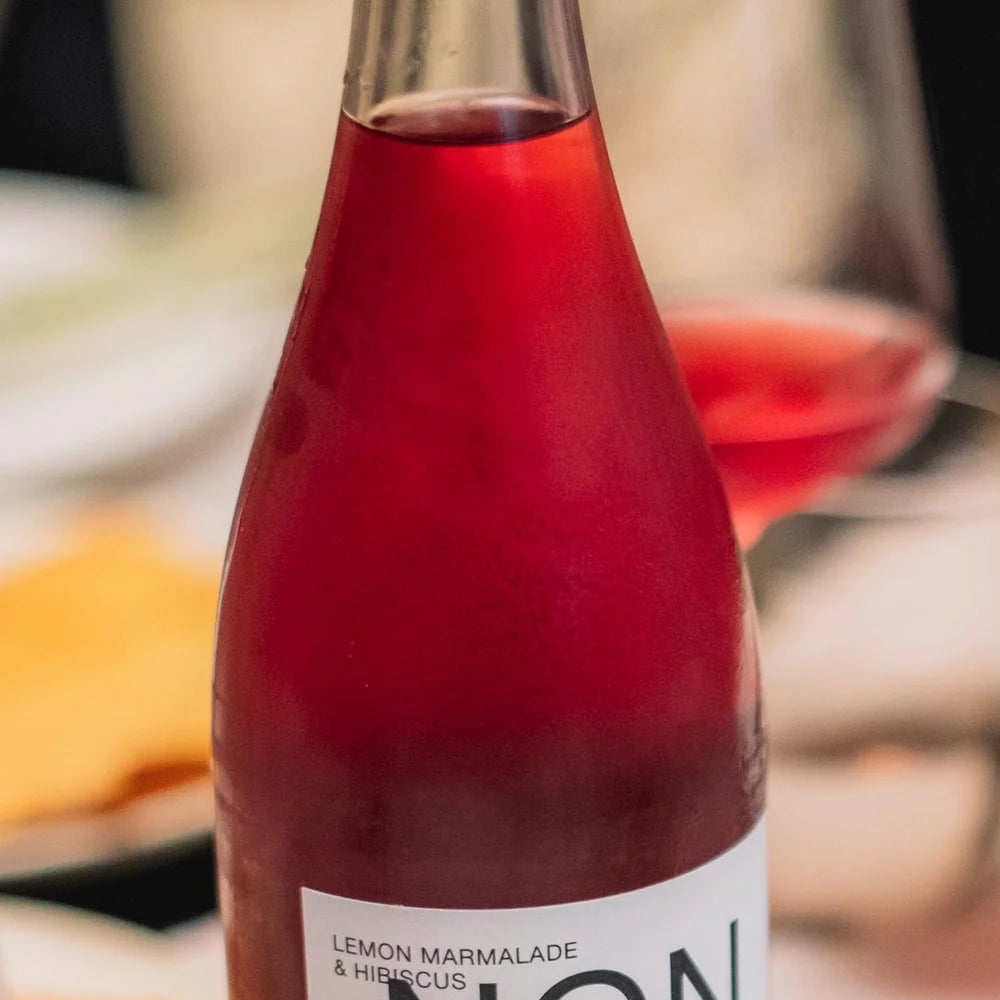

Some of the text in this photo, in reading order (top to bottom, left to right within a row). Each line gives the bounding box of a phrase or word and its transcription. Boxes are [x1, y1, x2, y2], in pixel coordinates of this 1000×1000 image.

[333, 934, 577, 966] LEMON MARMALADE
[334, 959, 467, 991] & HIBISCUS
